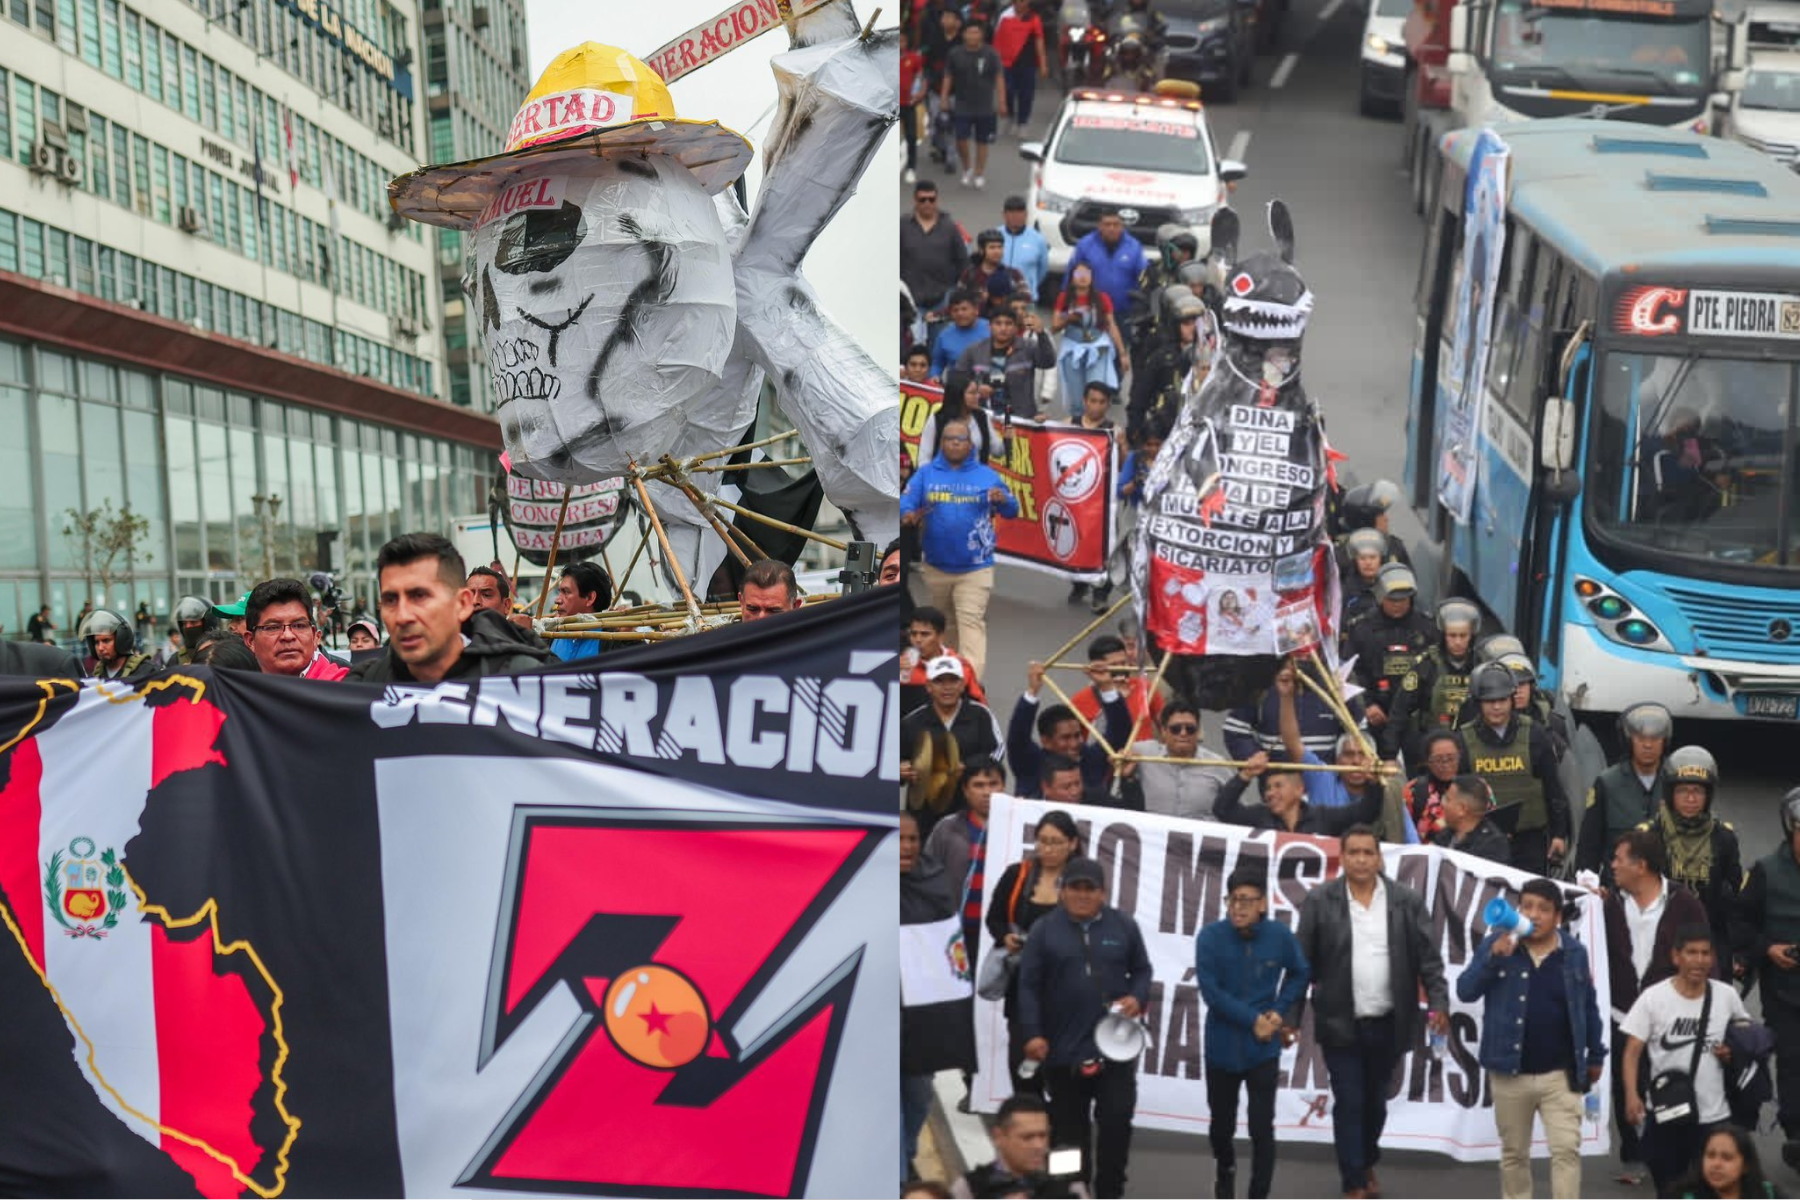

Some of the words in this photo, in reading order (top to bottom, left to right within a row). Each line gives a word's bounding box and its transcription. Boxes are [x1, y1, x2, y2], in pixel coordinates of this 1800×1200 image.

[321, 3, 342, 39] LA
[1694, 297, 1721, 329] PTE.
[1726, 298, 1775, 332] PIEDRA
[1235, 407, 1289, 429] DINA
[1239, 434, 1253, 451] Y
[1260, 434, 1286, 453] EL
[1218, 455, 1311, 484] ONGRESO
[509, 478, 532, 499] DE
[1257, 486, 1289, 508] DE
[1164, 496, 1260, 528] MURTE
[1268, 516, 1280, 531] A
[1288, 512, 1308, 528] LA
[1152, 517, 1272, 555] EXTORCION
[1279, 537, 1291, 553] Y
[1158, 544, 1272, 574] SICARIATO
[1475, 757, 1524, 773] POLICIA
[1671, 1017, 1702, 1036] NIK
